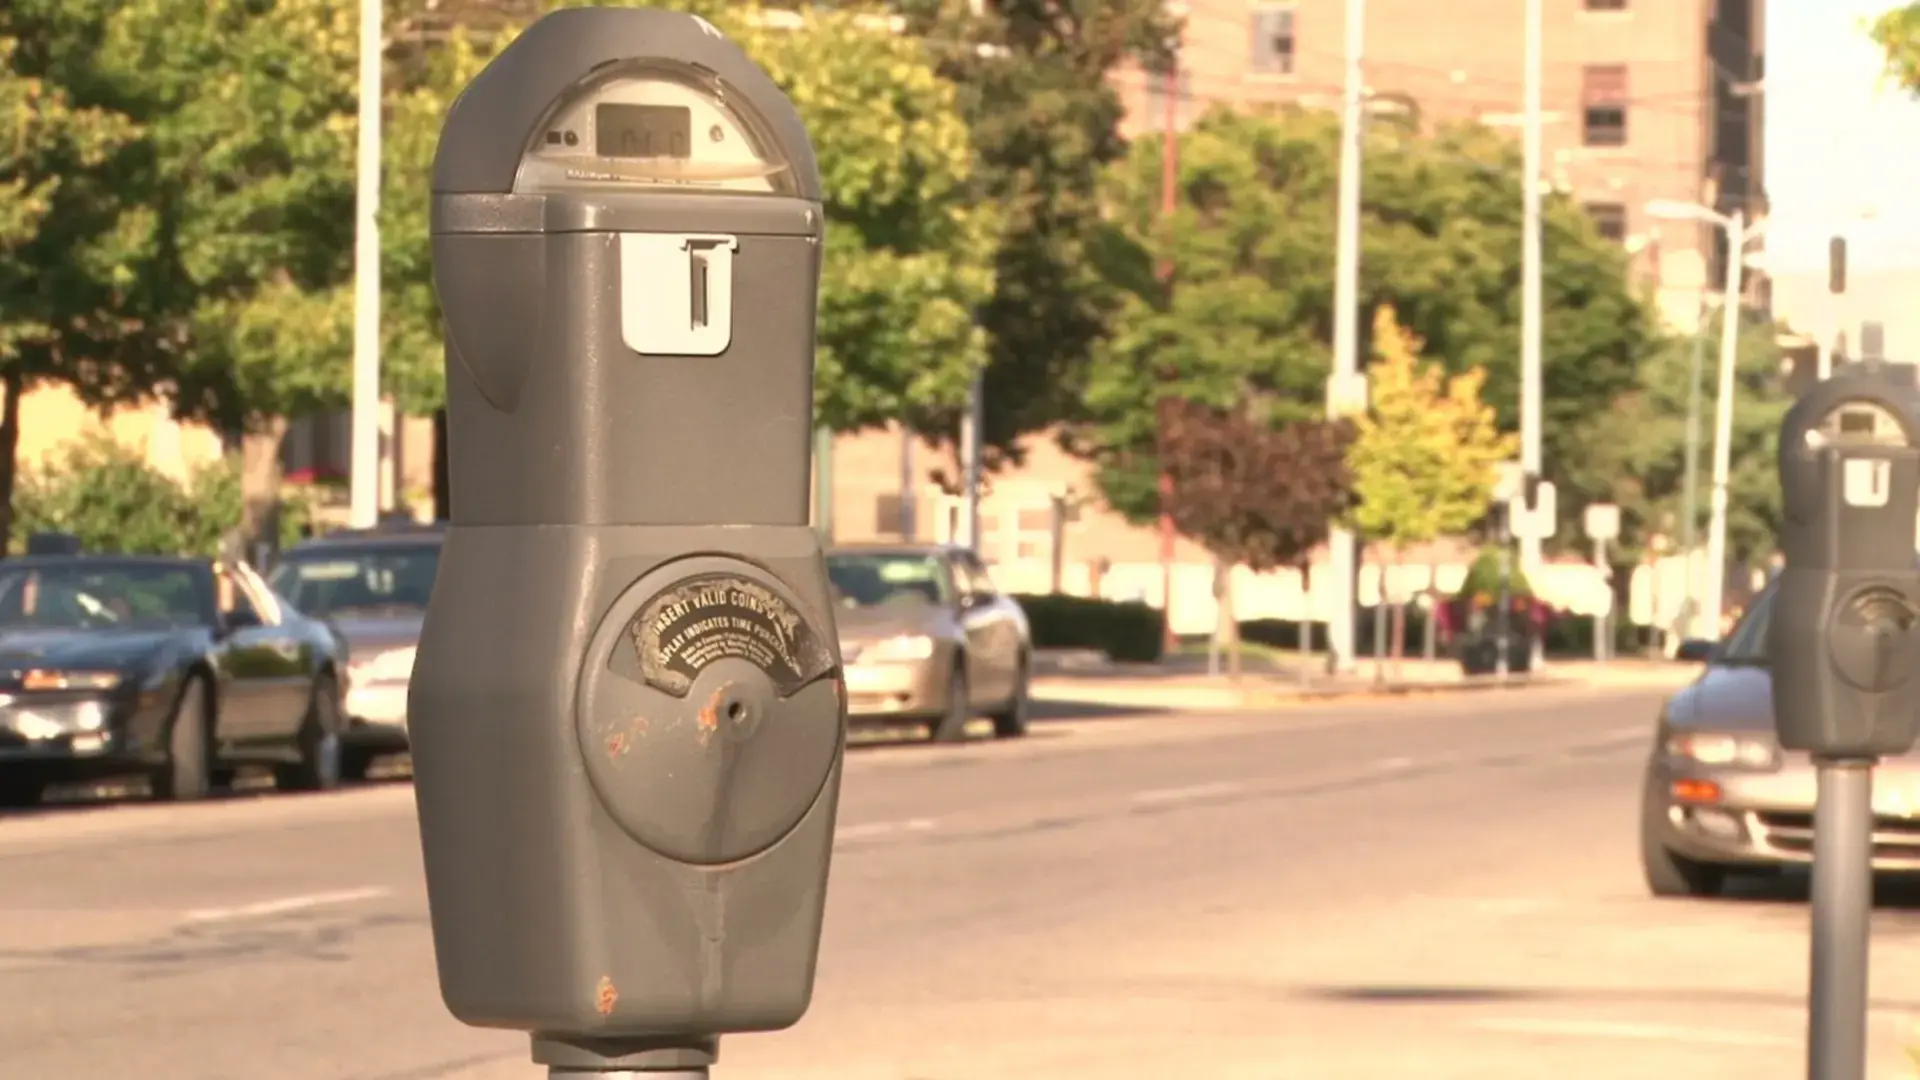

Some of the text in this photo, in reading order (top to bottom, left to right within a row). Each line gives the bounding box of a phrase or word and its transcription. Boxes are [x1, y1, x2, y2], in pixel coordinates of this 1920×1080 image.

[652, 590, 764, 636] INSERT VALID COINS
[657, 633, 686, 666] ISPLAY
[683, 616, 730, 640] INDICATES
[731, 616, 752, 632] TIME
